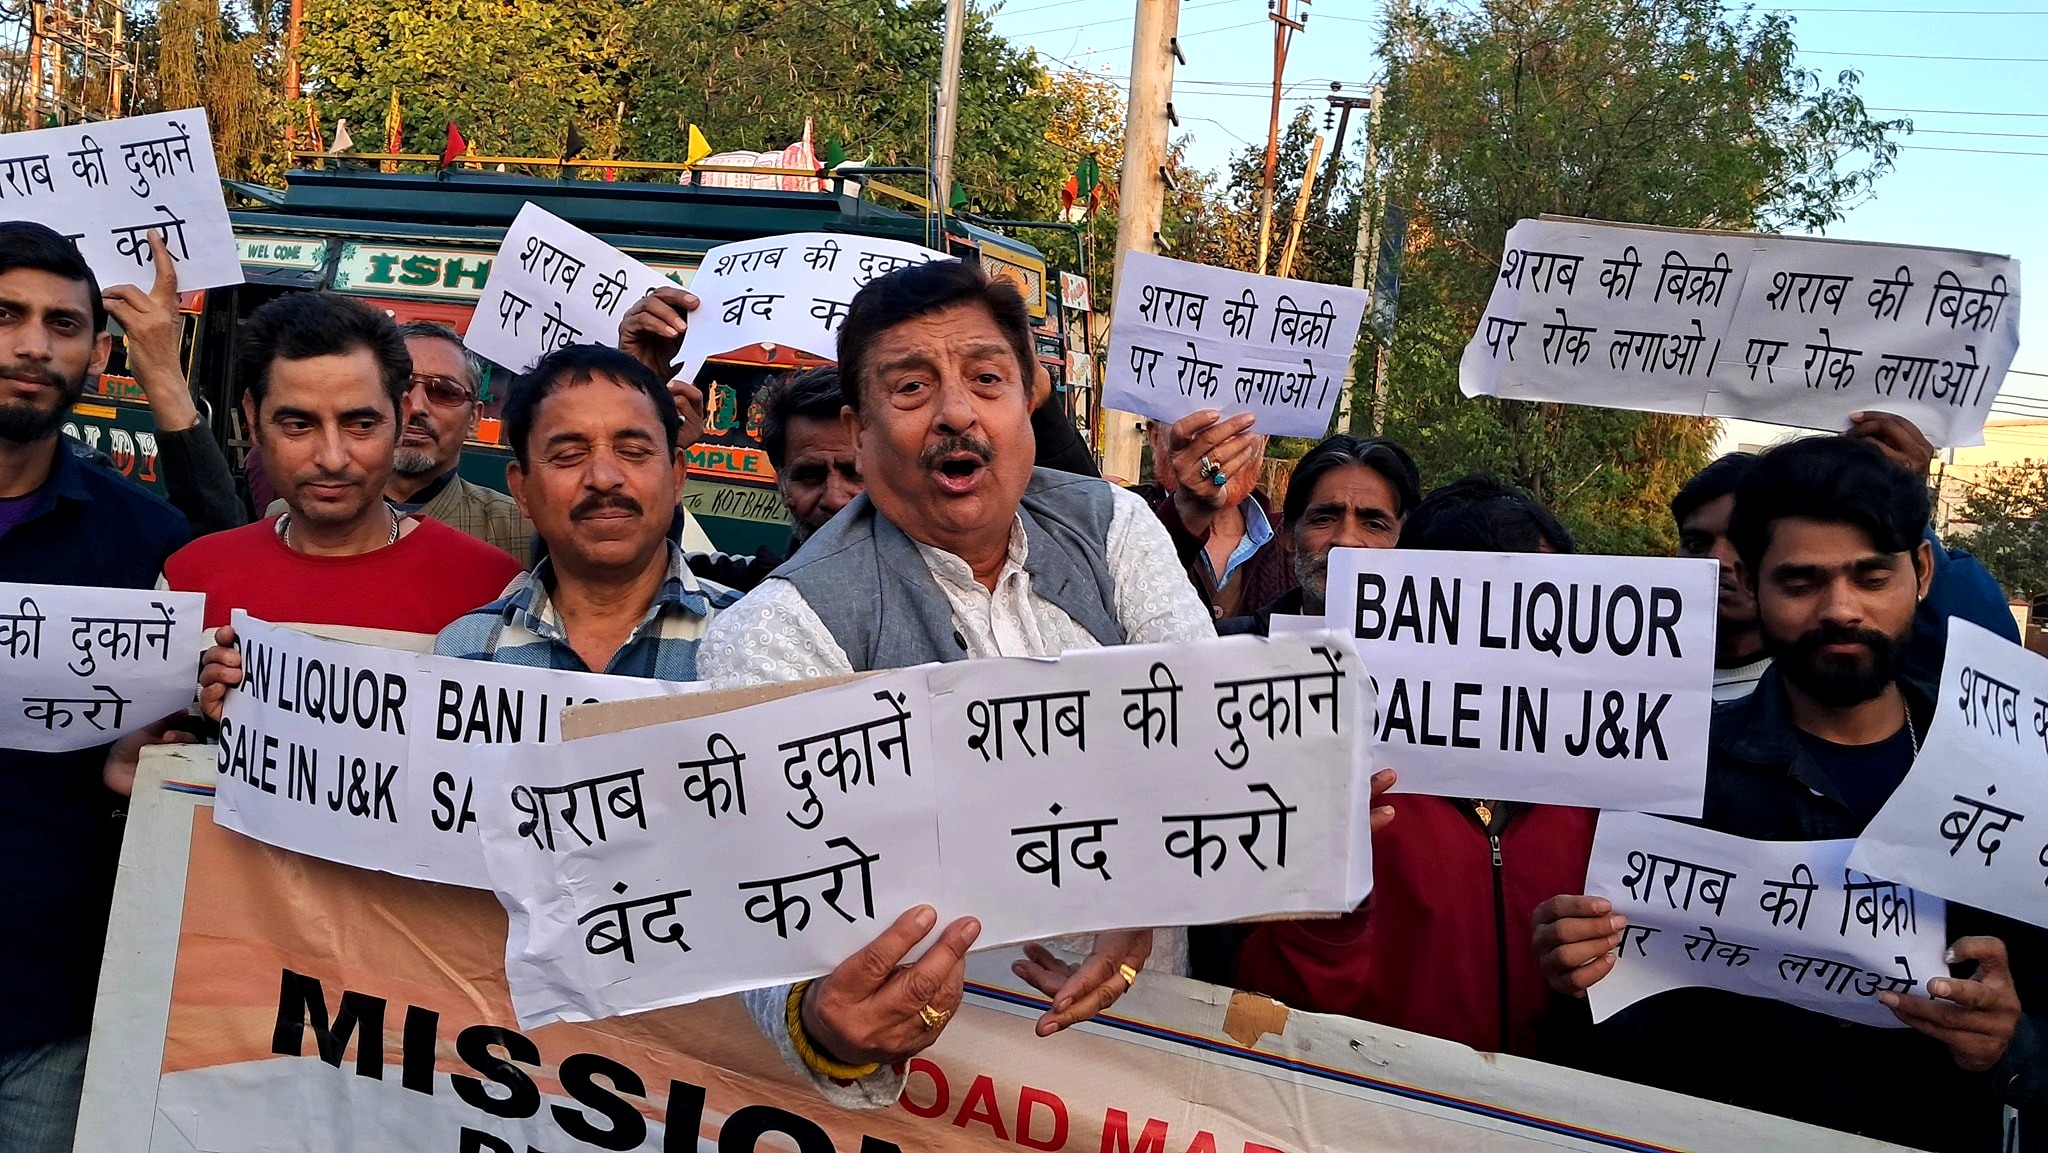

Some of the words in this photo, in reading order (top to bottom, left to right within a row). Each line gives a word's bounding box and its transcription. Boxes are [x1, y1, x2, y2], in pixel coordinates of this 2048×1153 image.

[67, 134, 109, 188] की
[120, 121, 195, 198] दुकानें
[273, 245, 302, 260] COME
[365, 253, 493, 290] ISH
[520, 236, 585, 294] शराब
[592, 269, 628, 316] की
[713, 247, 789, 276] शराब
[803, 239, 842, 272] की
[1501, 246, 1584, 296] शराब
[1599, 245, 1642, 302] की
[1654, 250, 1732, 307] बिक्री
[499, 290, 532, 337] पर
[722, 287, 785, 326] बंद
[1139, 284, 1209, 331] शराब
[1222, 288, 1258, 340] की
[1270, 294, 1337, 349] बिक्री
[1766, 270, 1853, 316] शराब
[1867, 265, 1914, 322] की
[1926, 270, 2009, 333] बिक्री
[1130, 345, 1164, 388] पर
[1177, 342, 1223, 400] रोक
[1486, 315, 1527, 362] पर
[1542, 308, 1597, 367] रोक
[1744, 336, 1789, 385] पर
[1804, 327, 1862, 391] रोक
[685, 450, 760, 473] MPLE
[711, 488, 790, 520] KOTBHAL
[67, 601, 176, 677] दुकानें
[1355, 572, 1462, 646] BAN
[1480, 581, 1683, 658] LIQUOR
[22, 685, 132, 731] करो
[278, 652, 407, 735] LIQUOR
[436, 679, 524, 744] BAN
[966, 689, 1090, 764] शराब
[1121, 662, 1184, 750] की
[1214, 646, 1346, 769] दुकानें
[1370, 675, 1483, 749] ALE
[1500, 685, 1549, 753] IN
[1564, 690, 1673, 761] J&K
[1959, 665, 2020, 744] शराब
[217, 717, 279, 795] SALE
[288, 742, 318, 805] IN
[327, 755, 399, 823] J&K
[511, 767, 648, 853] शराब
[677, 733, 747, 820] की
[778, 690, 912, 829] दुकानें
[1011, 802, 1119, 888] बंद
[1162, 783, 1298, 878] करो
[1940, 784, 2024, 867] बंद
[577, 882, 692, 964] बंद
[739, 835, 881, 940] करो
[1621, 850, 1737, 917] शराब
[1759, 863, 1819, 931] की
[1683, 925, 1760, 967] रोक
[1778, 956, 1920, 999] लगाओ
[897, 1058, 1069, 1152] OAD
